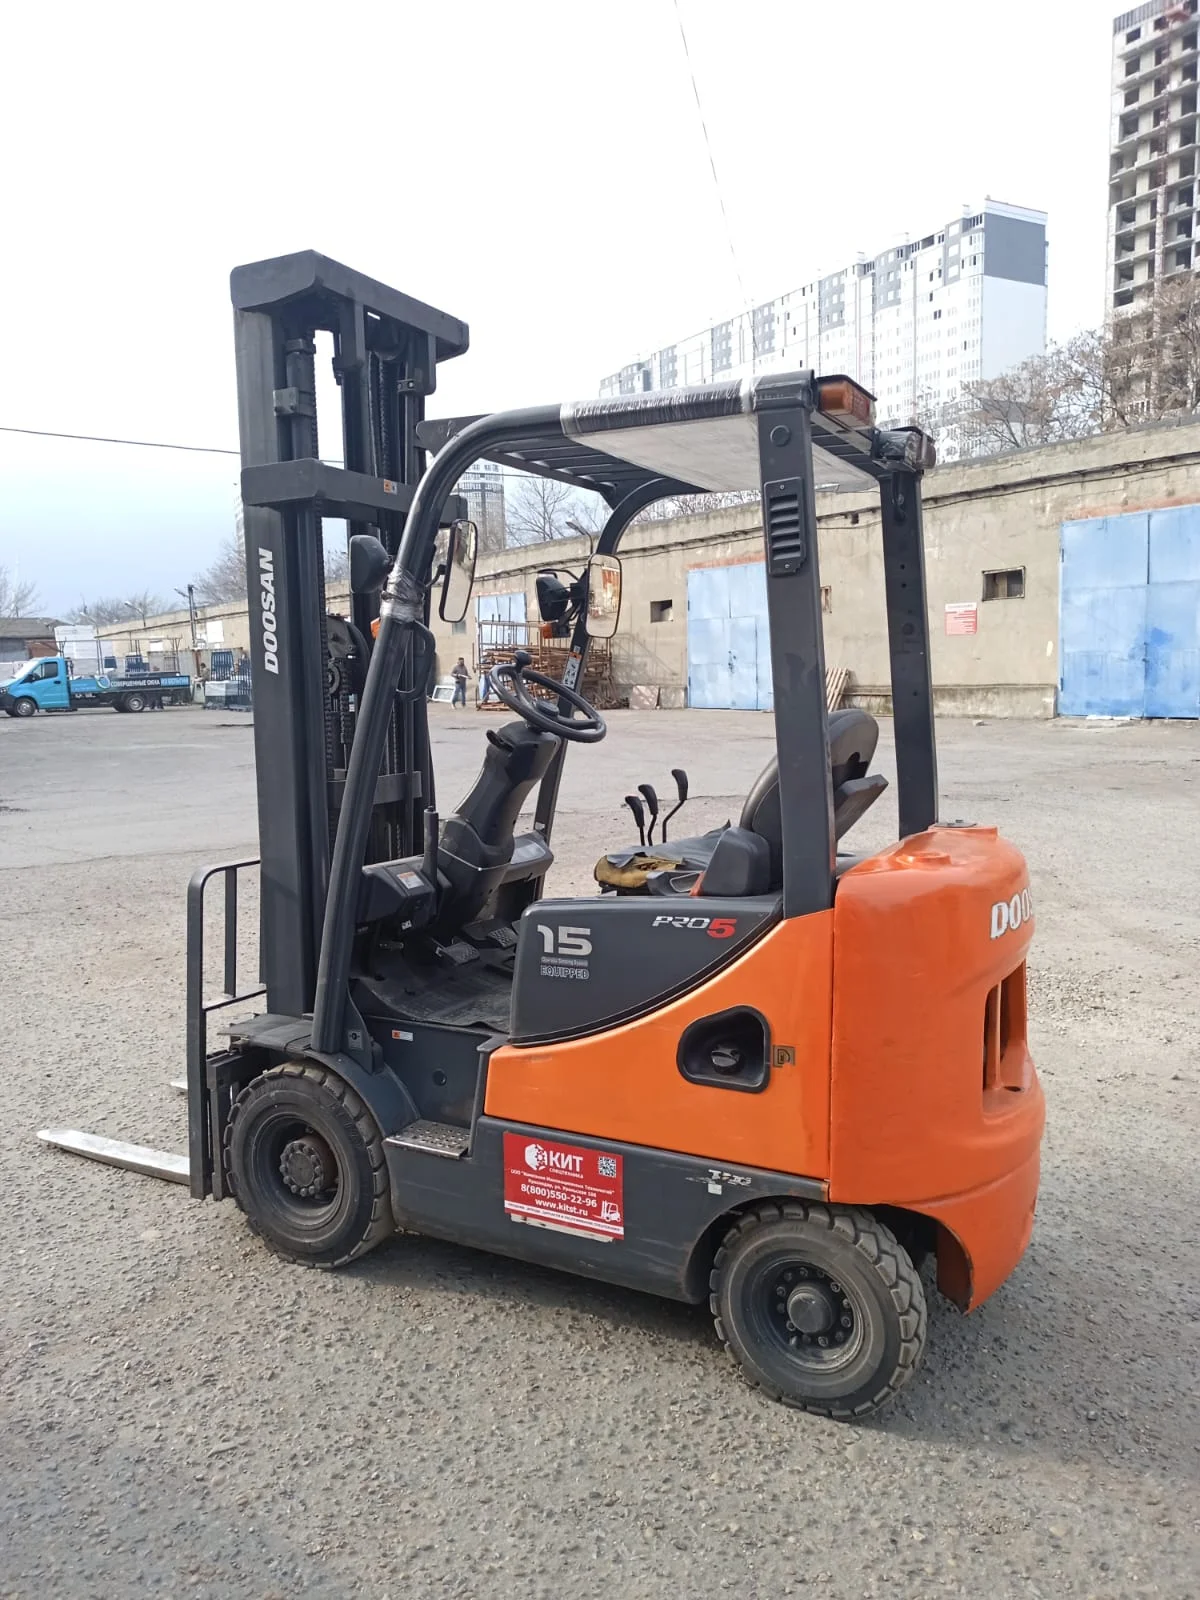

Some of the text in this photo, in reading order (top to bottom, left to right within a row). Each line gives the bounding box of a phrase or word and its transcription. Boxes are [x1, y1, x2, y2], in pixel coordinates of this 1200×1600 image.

[258, 547, 279, 675] DOOSAN
[990, 888, 1032, 939] DOO
[537, 924, 593, 956] 15
[540, 964, 590, 980] EQUIPPED
[549, 1150, 584, 1172] КИТ
[520, 1183, 598, 1208] 8(800)550-22-96
[535, 1199, 588, 1217] www.kitst.ru
